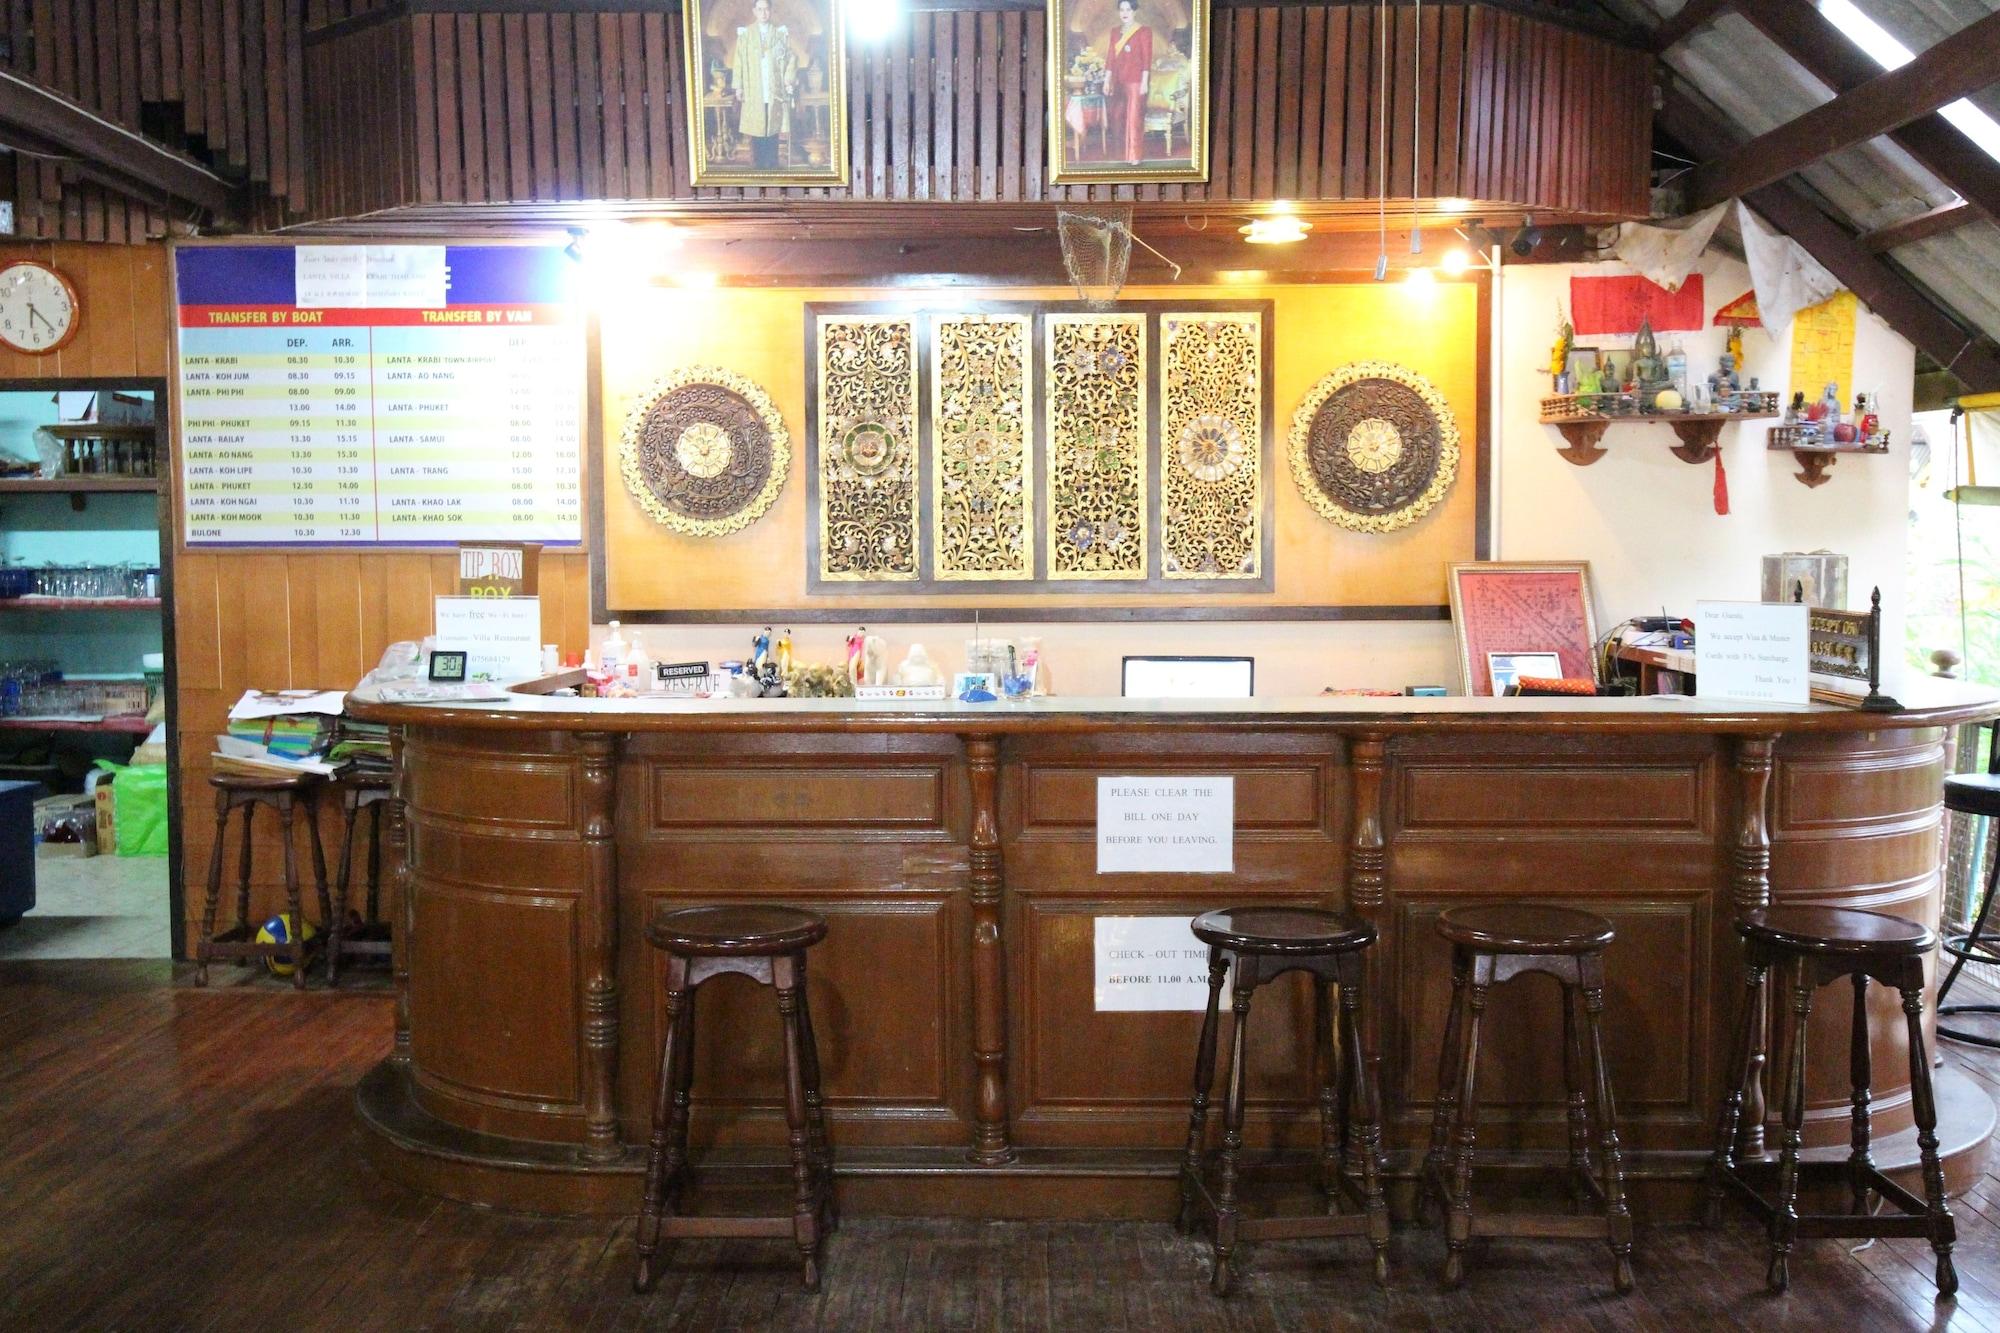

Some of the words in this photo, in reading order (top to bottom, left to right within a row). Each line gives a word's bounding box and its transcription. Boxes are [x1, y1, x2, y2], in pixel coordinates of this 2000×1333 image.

[0, 287, 11, 298] 10
[53, 286, 61, 296] 2
[61, 301, 68, 312] 3
[208, 311, 267, 323] TRANSFER
[272, 311, 287, 323] BY
[292, 311, 324, 323] BOAT
[422, 310, 481, 323] TRANSFER
[486, 310, 502, 322] BY
[507, 310, 533, 322] VAN
[5, 319, 11, 329] 8
[58, 318, 64, 327] 4
[19, 330, 25, 340] 7
[33, 333, 40, 343] 6
[287, 338, 308, 348] DEP.
[332, 338, 354, 348] ARR.
[463, 552, 484, 577] TIP
[491, 552, 521, 578] BOX
[469, 610, 485, 619] free
[662, 665, 705, 677] RESERVED
[1110, 788, 1150, 797] PLEASE
[1154, 788, 1188, 797] CLEAR
[1194, 788, 1213, 797] THE
[1124, 812, 1146, 821] BILL
[1151, 812, 1173, 821] ONE
[1177, 812, 1200, 821] DAY
[1105, 836, 1143, 844] BEFORE
[1147, 836, 1168, 844] YOU
[1172, 836, 1218, 845] LEAVING.
[1108, 950, 1144, 959] CHECK
[1155, 950, 1177, 959] OUT
[1182, 950, 1208, 959] TIME
[1108, 975, 1152, 984] BEFORE
[1157, 975, 1182, 984] 11.00
